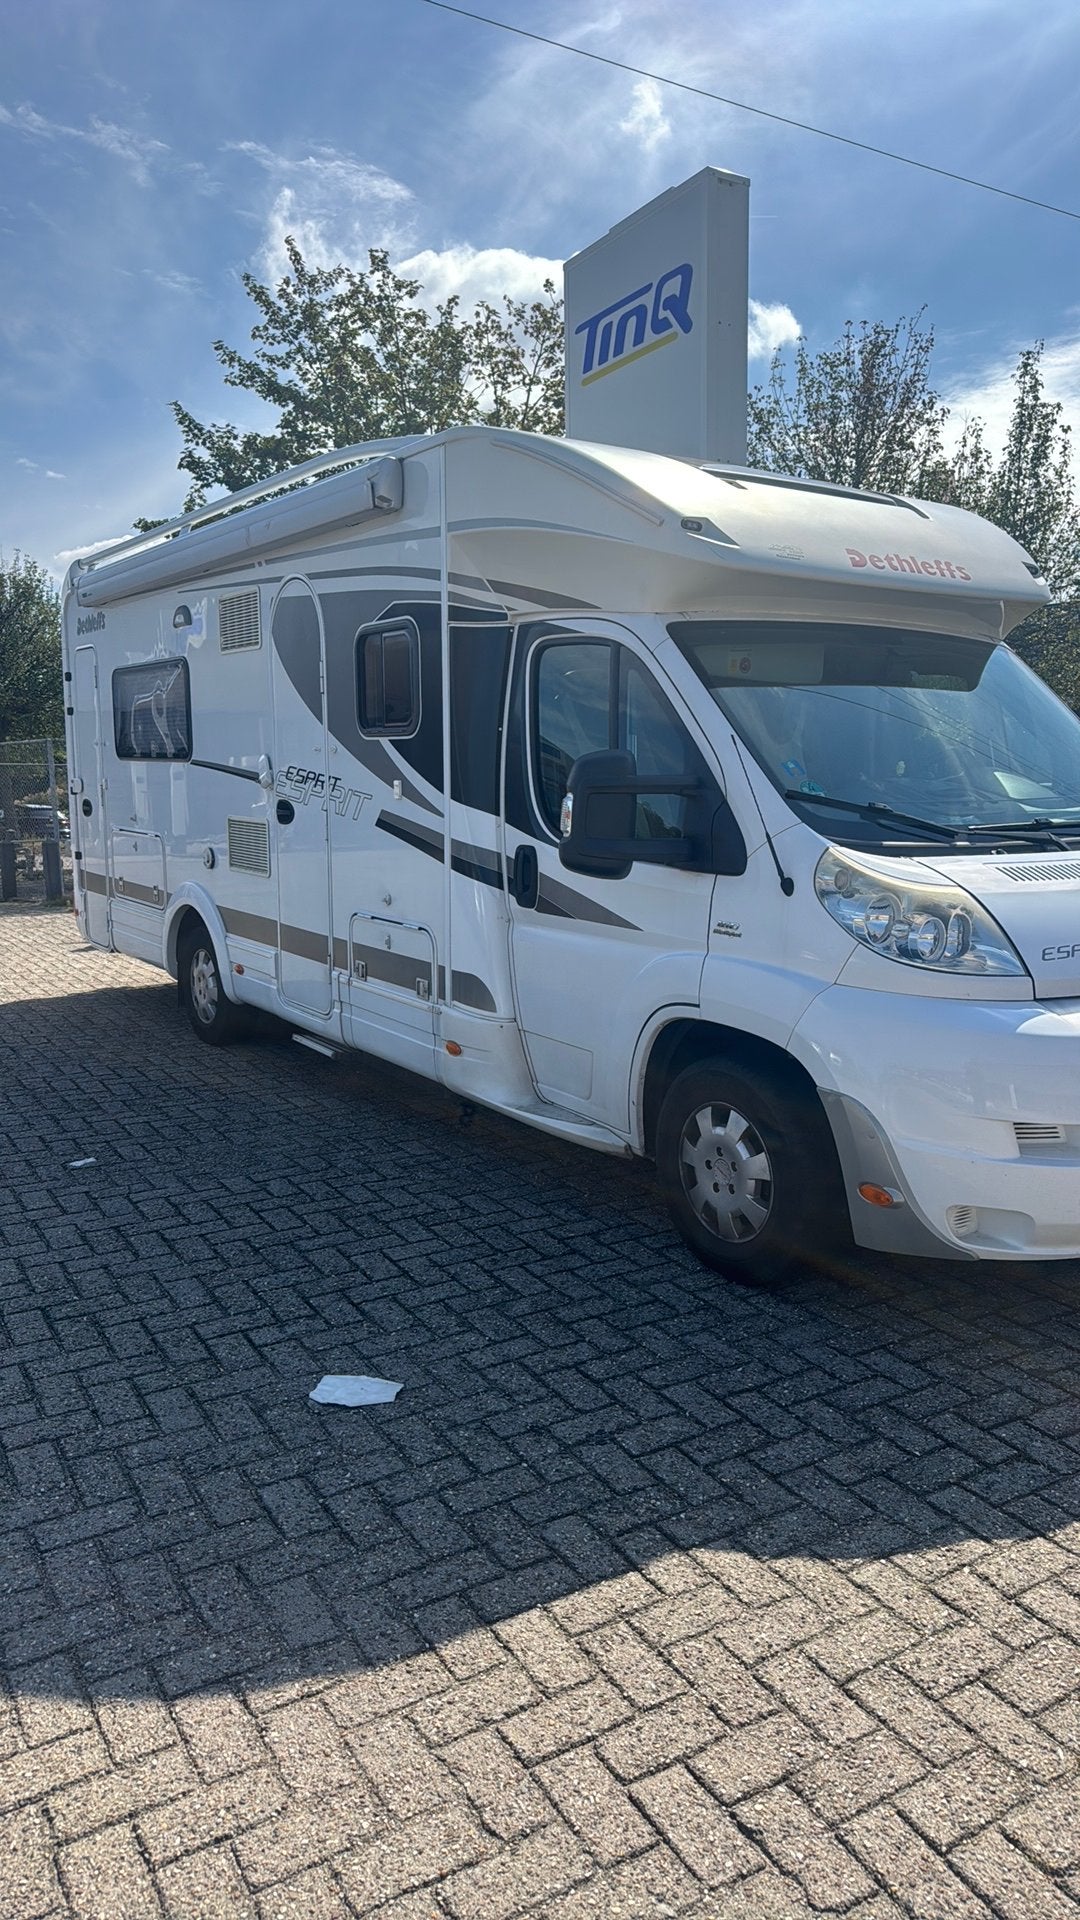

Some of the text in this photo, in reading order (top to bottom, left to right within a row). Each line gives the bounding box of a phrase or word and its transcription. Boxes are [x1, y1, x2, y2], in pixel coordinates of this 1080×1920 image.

[574, 263, 694, 375] TinQ
[845, 548, 972, 581] Dethleffs
[275, 770, 374, 821] ESPRIT
